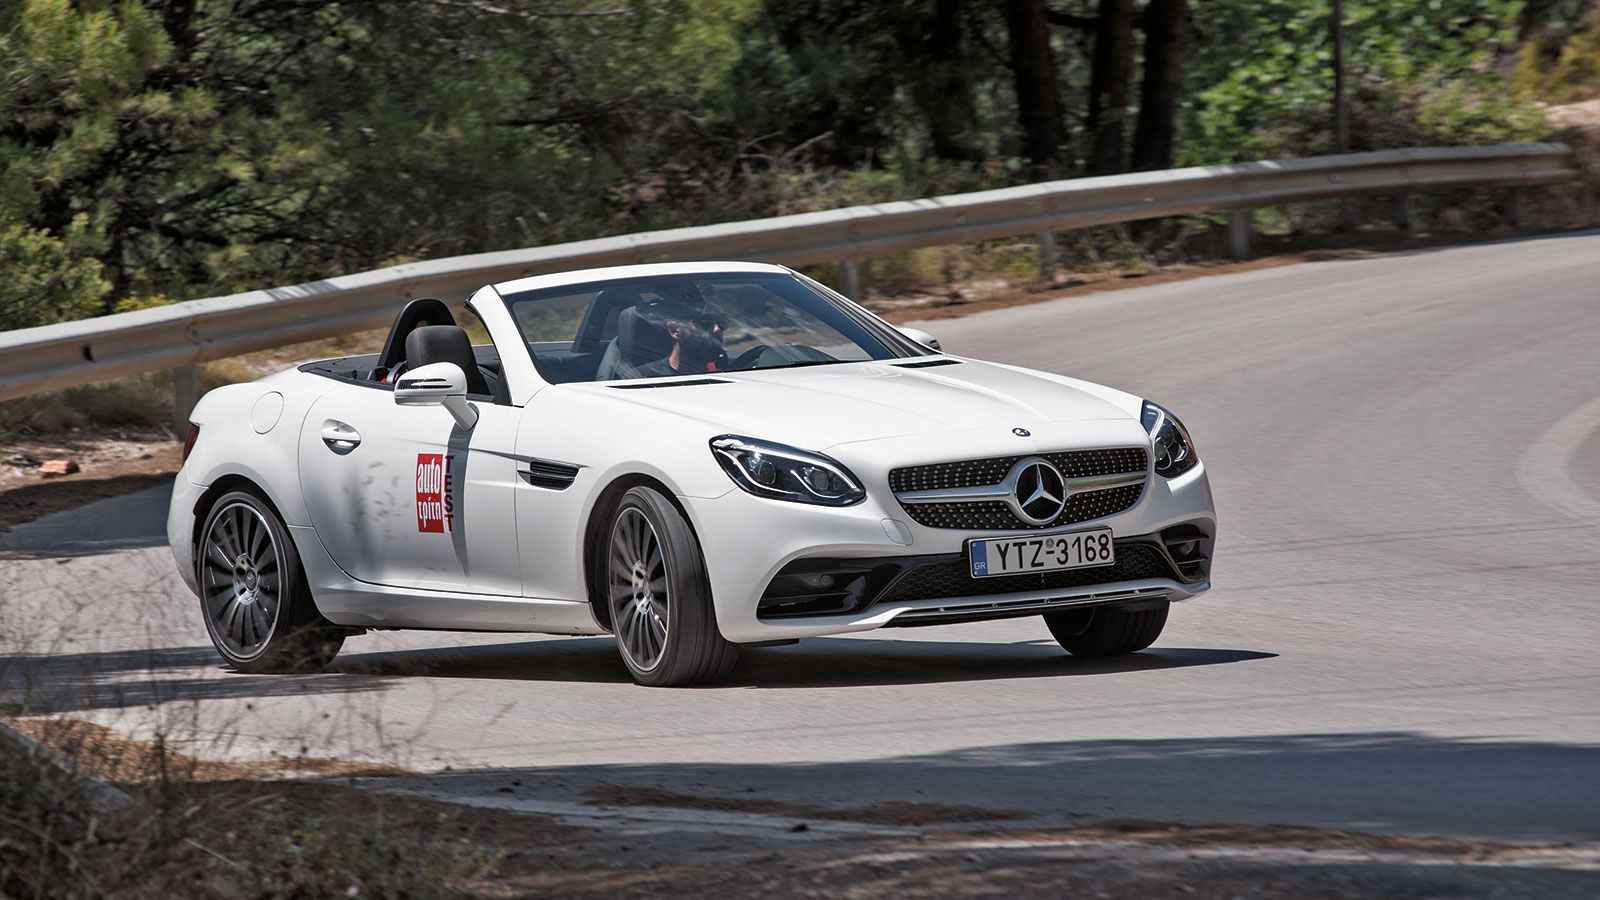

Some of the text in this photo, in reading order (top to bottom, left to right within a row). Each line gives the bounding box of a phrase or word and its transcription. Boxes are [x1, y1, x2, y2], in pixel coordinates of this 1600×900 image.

[417, 457, 441, 494] auto
[444, 455, 455, 532] TEST
[973, 562, 986, 571] GR
[995, 533, 1111, 571] YTZ-3168
